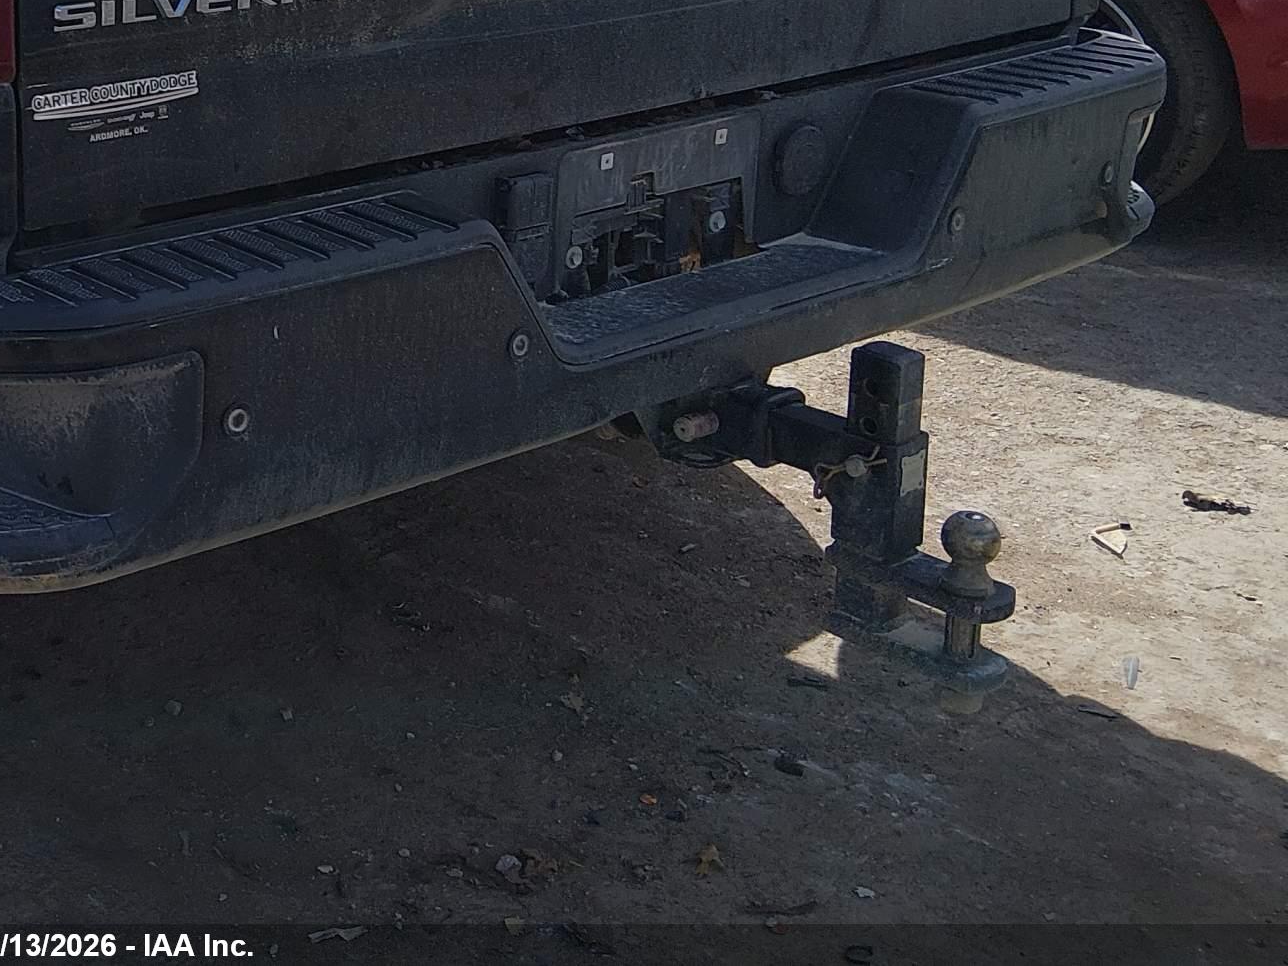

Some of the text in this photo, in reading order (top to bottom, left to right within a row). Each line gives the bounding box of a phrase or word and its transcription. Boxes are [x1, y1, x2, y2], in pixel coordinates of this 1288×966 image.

[33, 71, 197, 111] CARTER COUNTY DODGE
